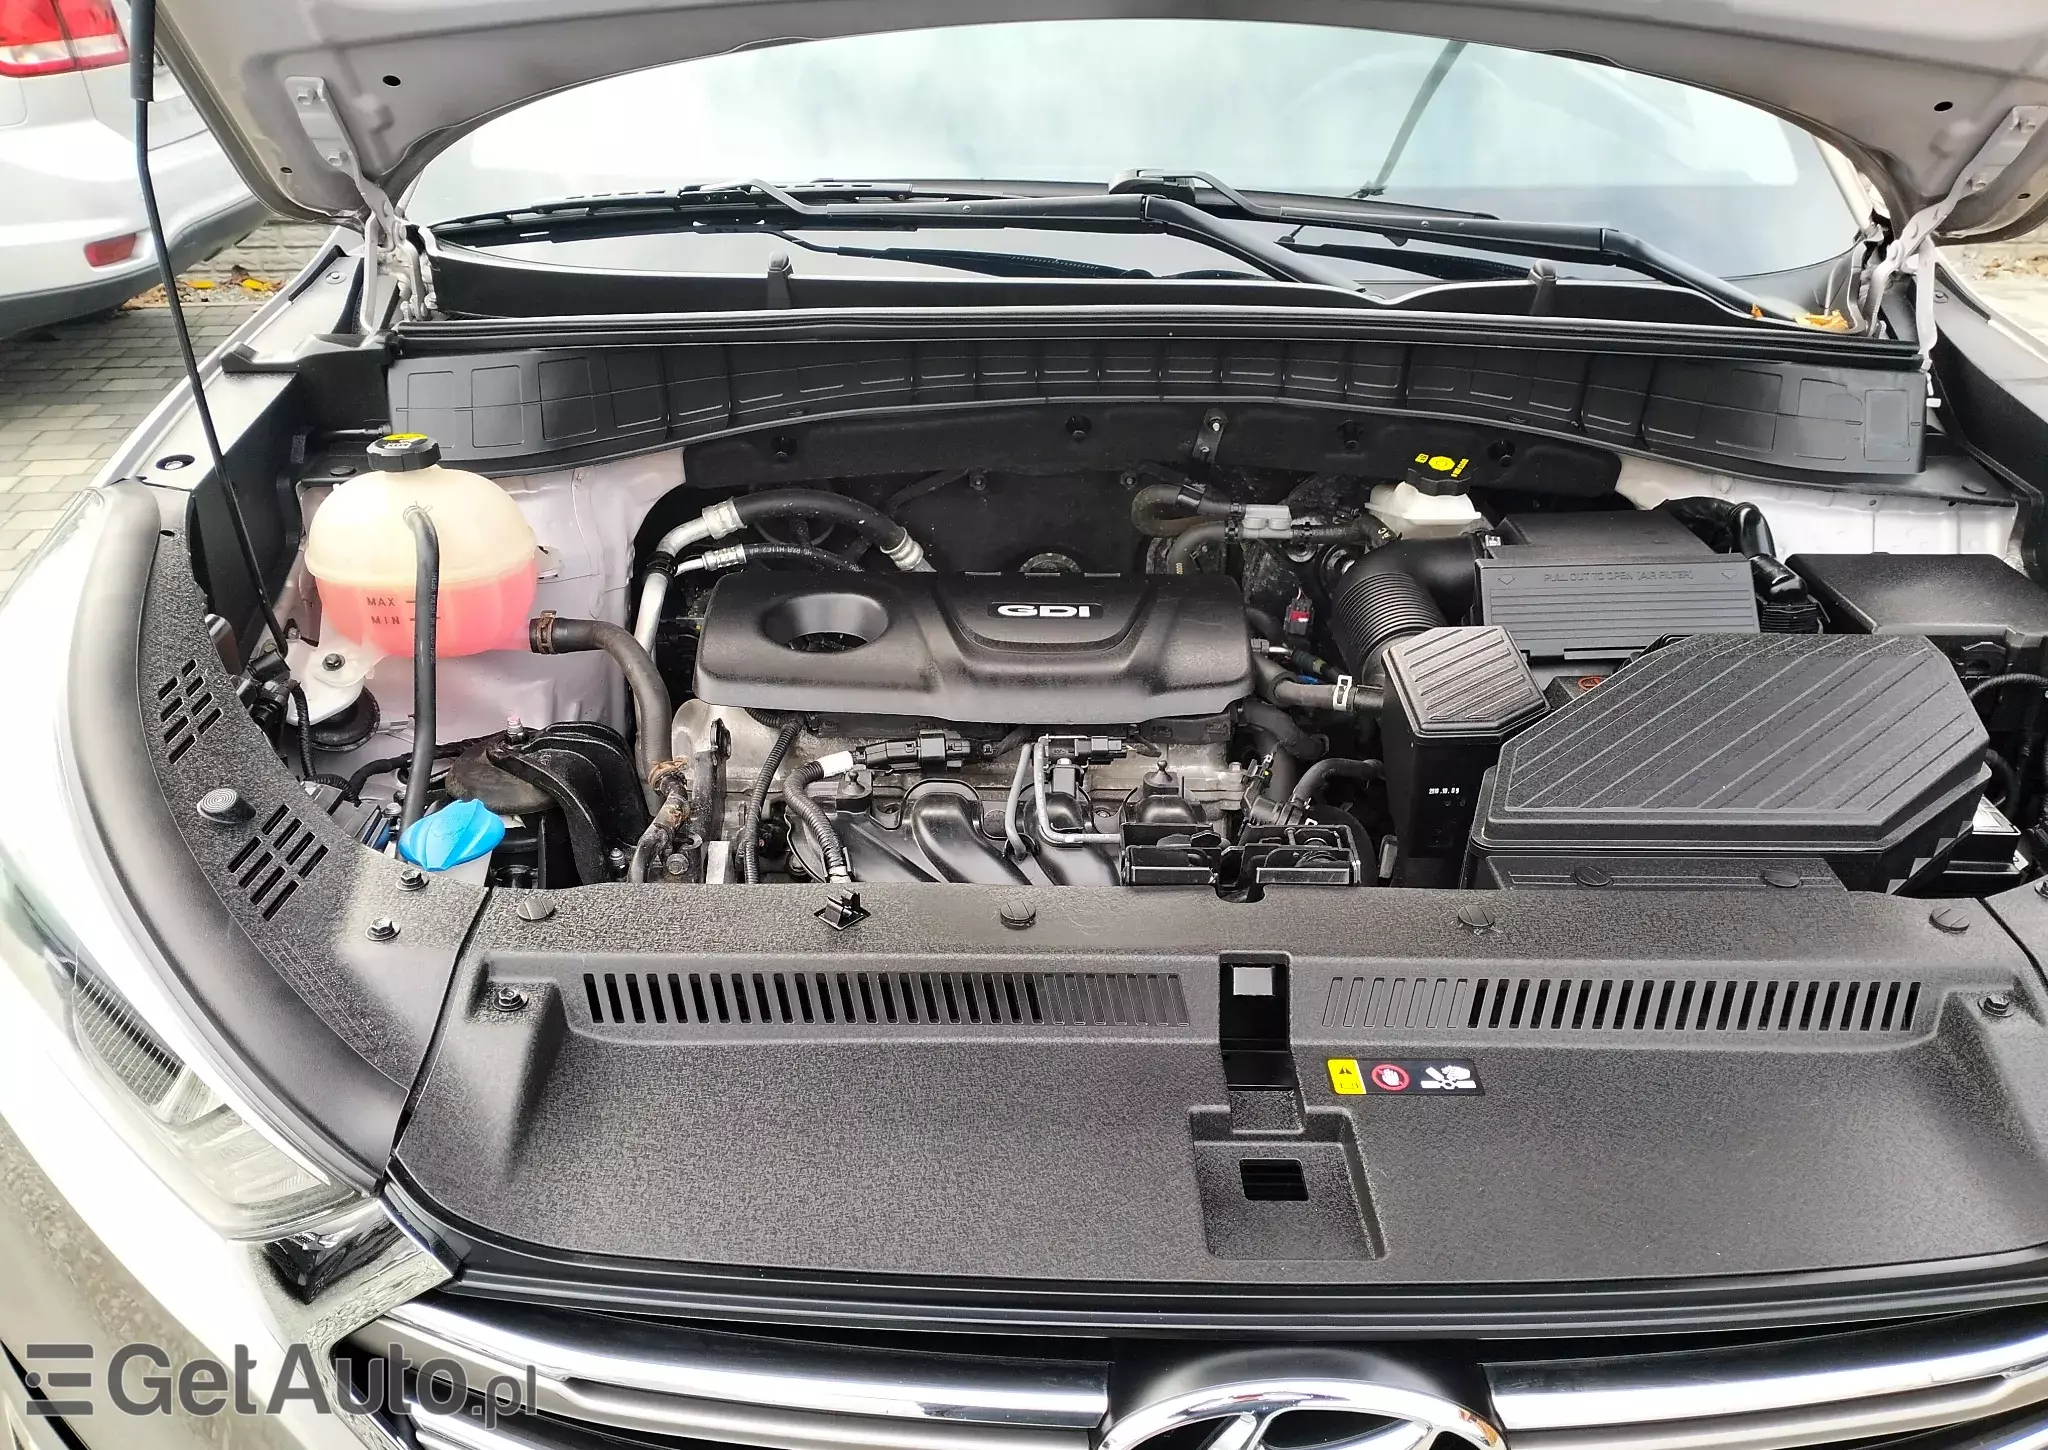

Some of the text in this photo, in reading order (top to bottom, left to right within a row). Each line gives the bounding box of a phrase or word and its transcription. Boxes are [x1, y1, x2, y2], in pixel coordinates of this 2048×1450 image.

[1544, 573, 1569, 582] PULL
[1569, 572, 1590, 582] OUT
[1590, 571, 1605, 581] TO
[1606, 571, 1634, 581] OPEN
[366, 596, 396, 607] MAX
[997, 604, 1091, 618] GDI
[370, 615, 400, 625] MIN
